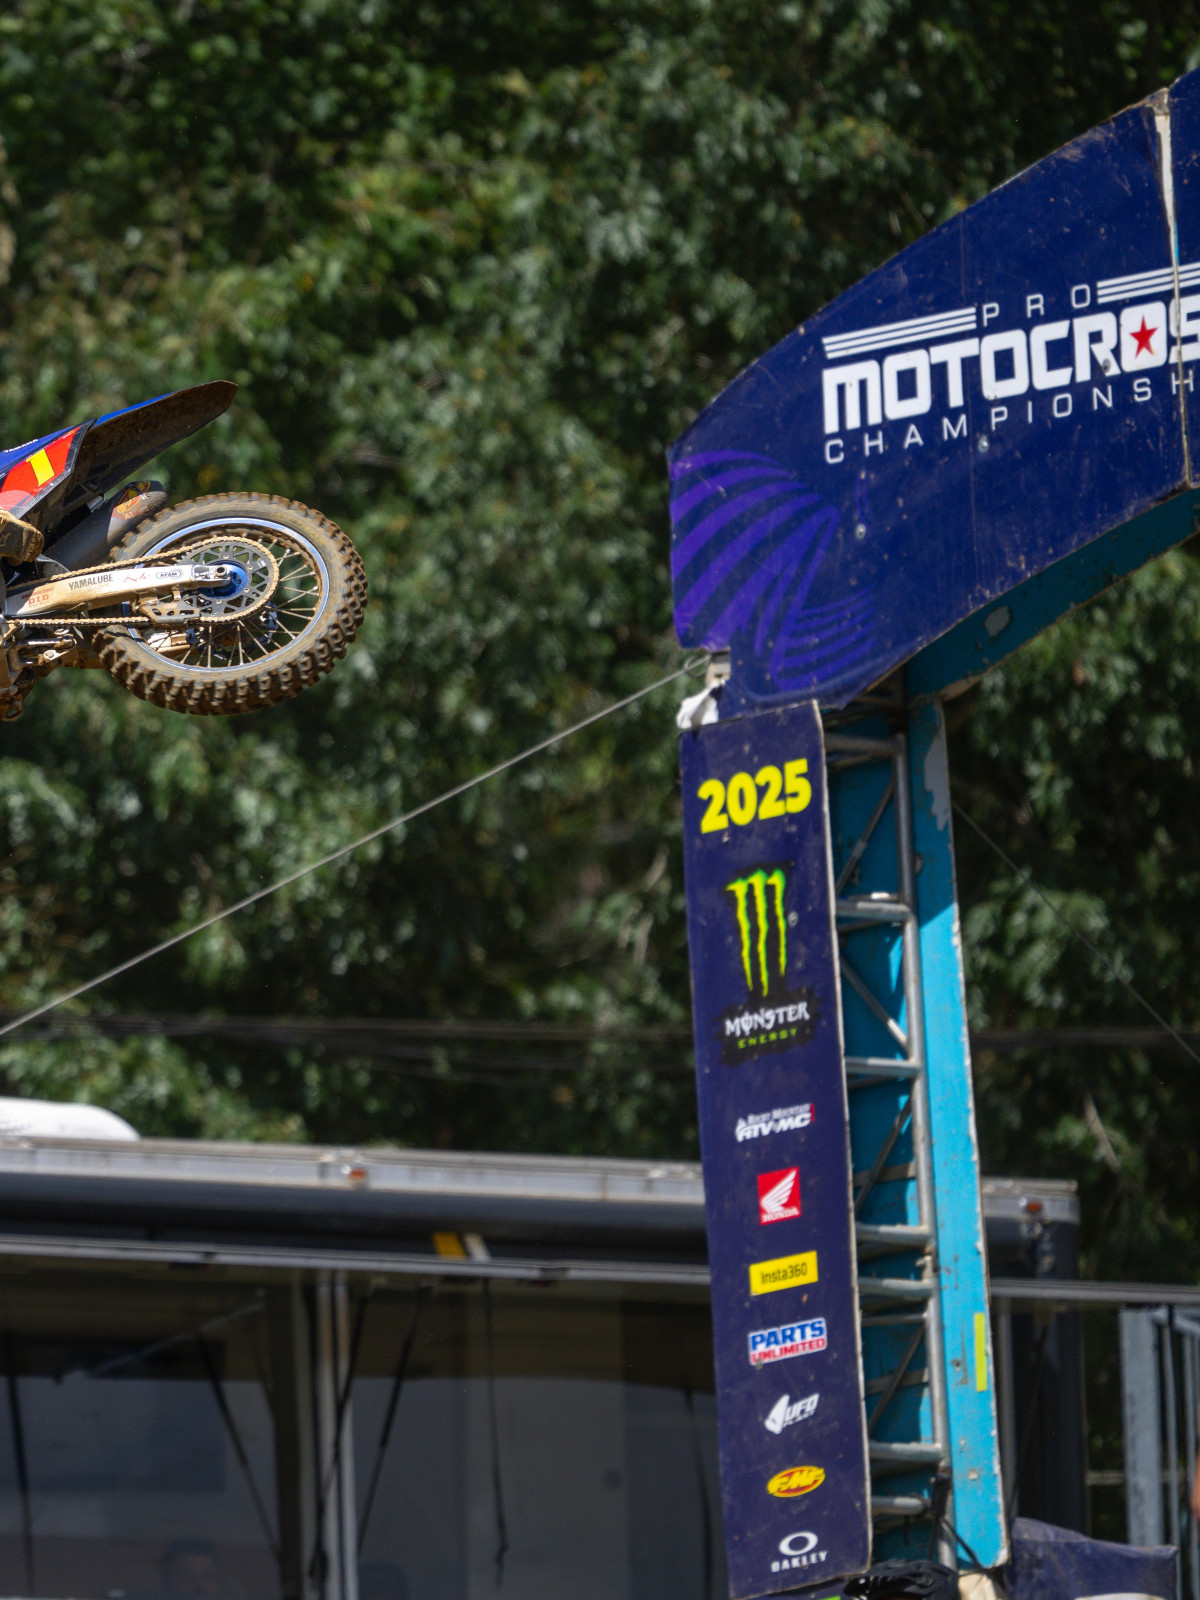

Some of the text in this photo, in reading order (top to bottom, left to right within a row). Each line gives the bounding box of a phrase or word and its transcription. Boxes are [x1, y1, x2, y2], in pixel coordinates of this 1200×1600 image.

[982, 284, 1091, 327] PRO
[825, 368, 1195, 464] CHAMPIONSH
[25, 448, 55, 488] 1
[68, 573, 114, 591] YAMALUBE
[697, 758, 812, 834] 2025
[725, 1002, 810, 1038] MONSTER
[738, 1027, 797, 1049] ENERGY
[761, 1207, 800, 1223] HONDA
[750, 1320, 825, 1351] PARTS
[751, 1338, 827, 1363] UNLIMITED
[784, 1394, 819, 1421] UFO
[768, 1467, 825, 1494] FMF
[771, 1551, 828, 1572] OAKLEY
